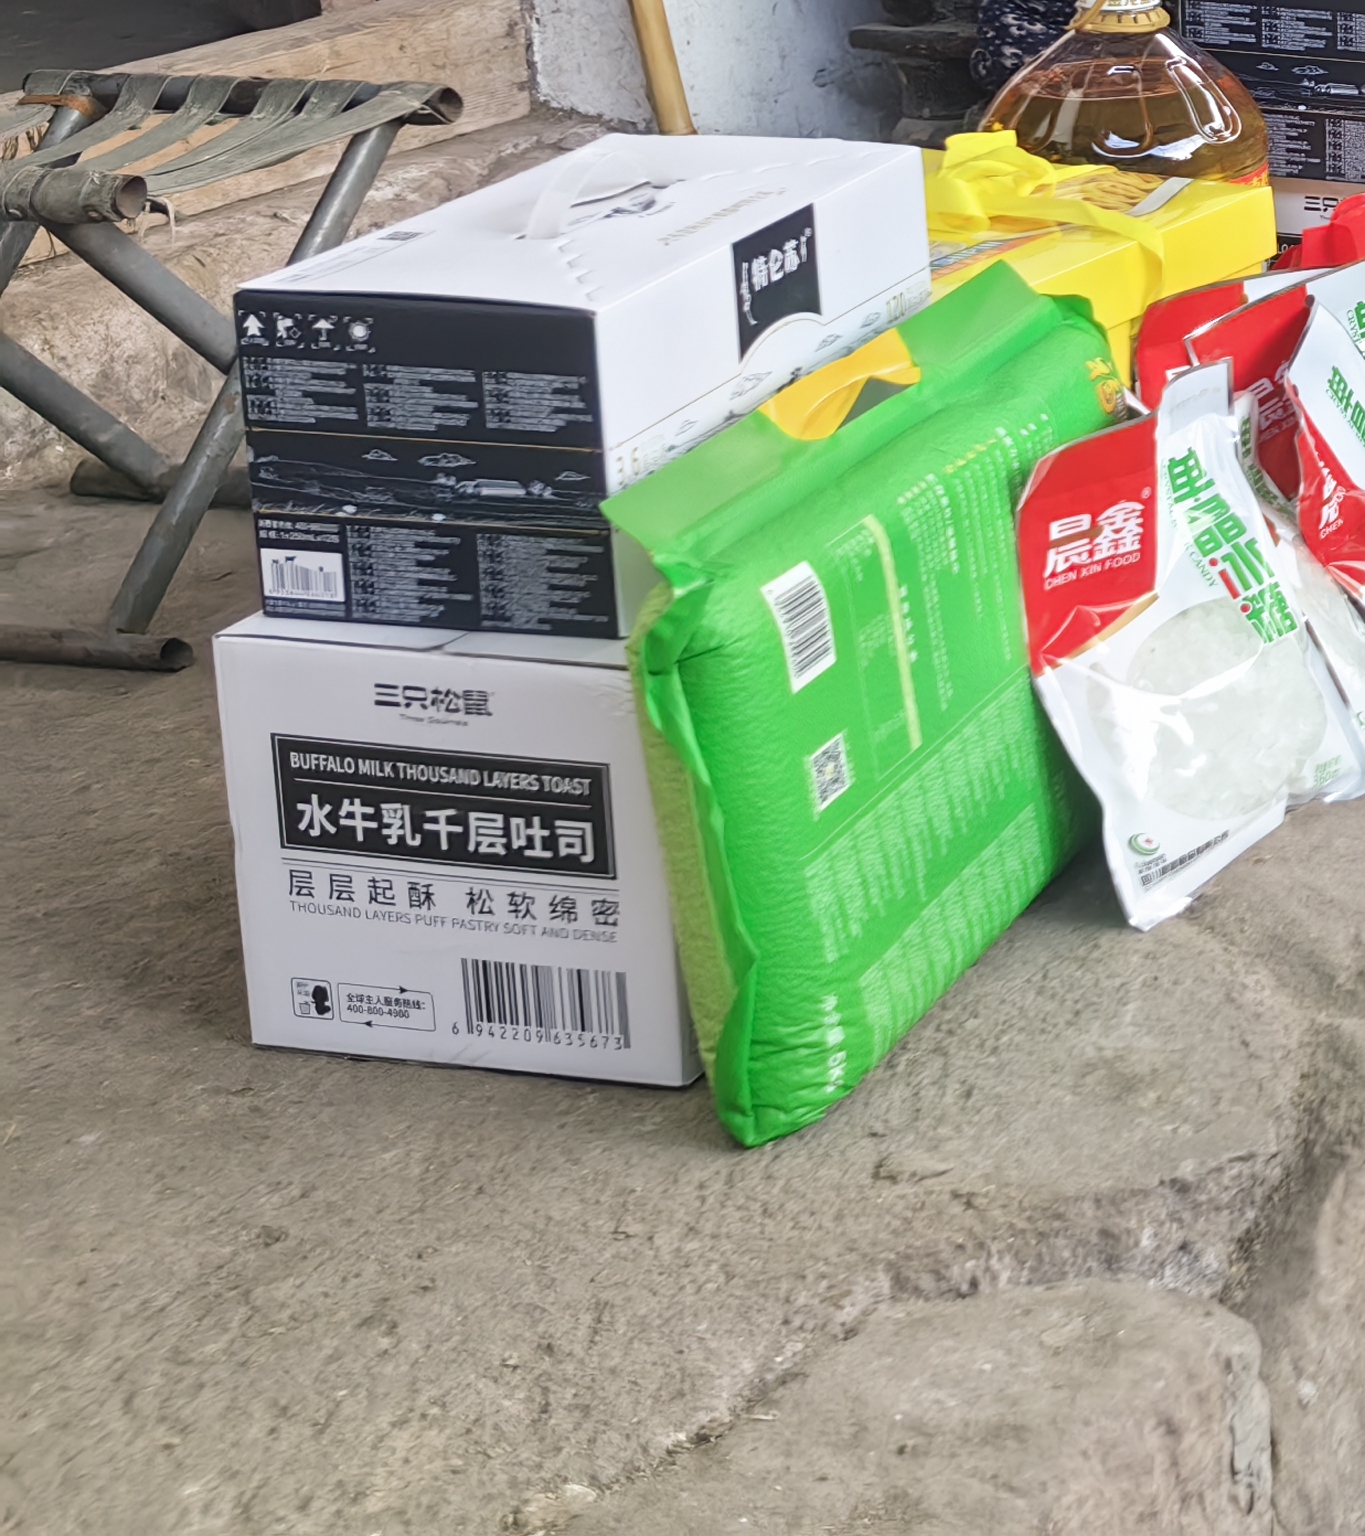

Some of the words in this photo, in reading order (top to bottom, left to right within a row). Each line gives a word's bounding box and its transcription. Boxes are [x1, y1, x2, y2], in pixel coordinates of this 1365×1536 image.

[751, 237, 800, 292] 特仑苏
[1043, 500, 1146, 578] 晨鑫
[1044, 570, 1078, 592] CHEN
[1080, 562, 1102, 579] XIN
[1104, 552, 1141, 570] FOOD
[374, 682, 493, 717] 三只松鼠
[289, 751, 355, 775] BUFFALO
[358, 758, 394, 778] MILK
[396, 762, 481, 787] THOUSAND
[483, 770, 540, 792] LAYERS
[542, 775, 592, 796] TOAST
[296, 793, 595, 863] 水牛乳千层吐司
[289, 869, 436, 911] 层层起酥
[465, 886, 620, 927] 松软绵密
[289, 900, 362, 919] THOUSAND
[365, 910, 411, 924] LAYERS
[415, 914, 447, 928] PUFF
[451, 917, 501, 933] PASTRY
[503, 923, 538, 936] SOFT
[541, 926, 569, 939] AND
[573, 929, 618, 943] DENSE
